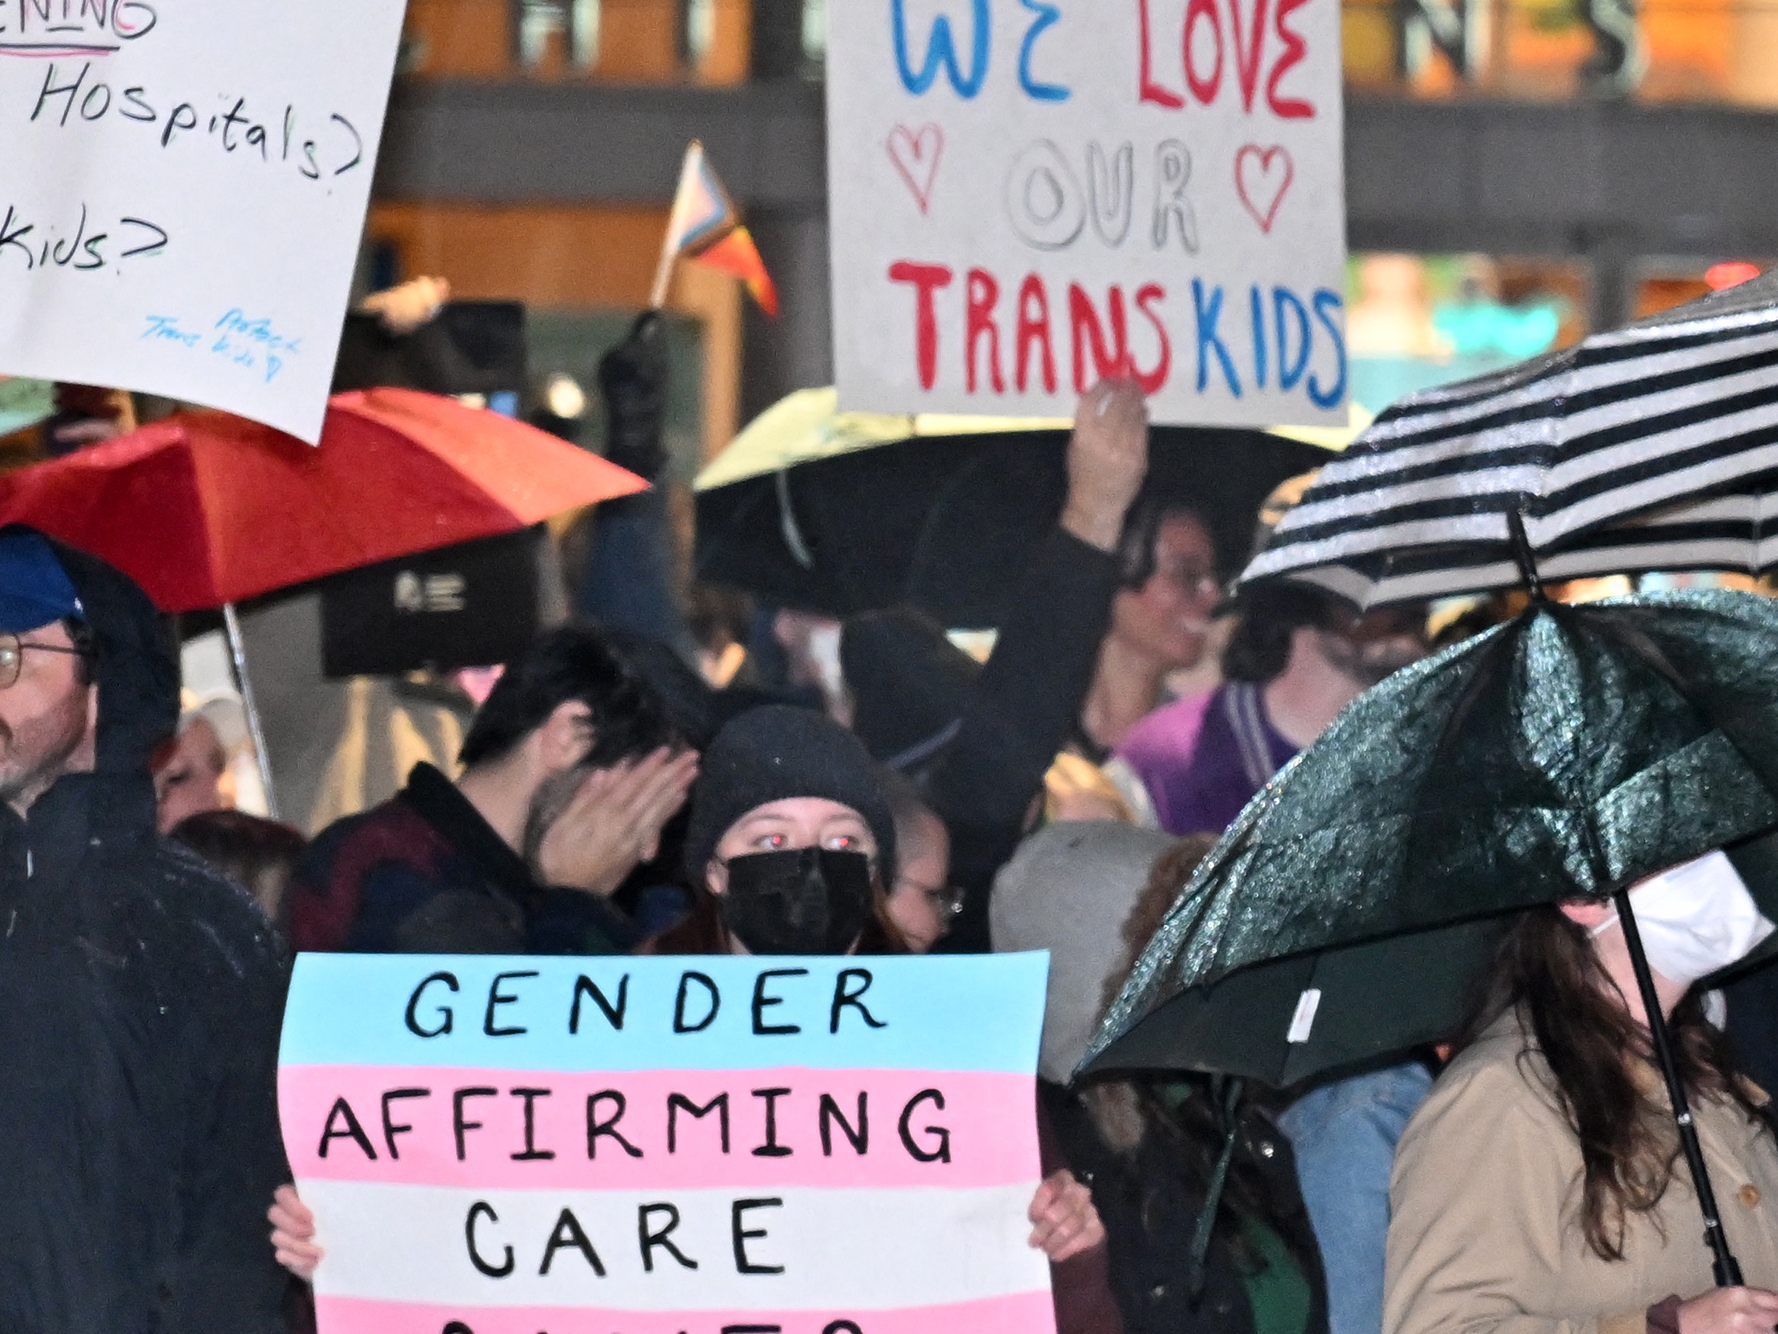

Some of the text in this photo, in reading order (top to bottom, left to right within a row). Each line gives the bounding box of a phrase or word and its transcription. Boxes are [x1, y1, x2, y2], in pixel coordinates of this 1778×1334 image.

[1004, 136, 1199, 255] OUR
[887, 258, 1348, 409] TRANS KIDS
[402, 966, 890, 1040] GENDER
[317, 1085, 953, 1166] AFFIRMING
[463, 1196, 786, 1280] CARE
